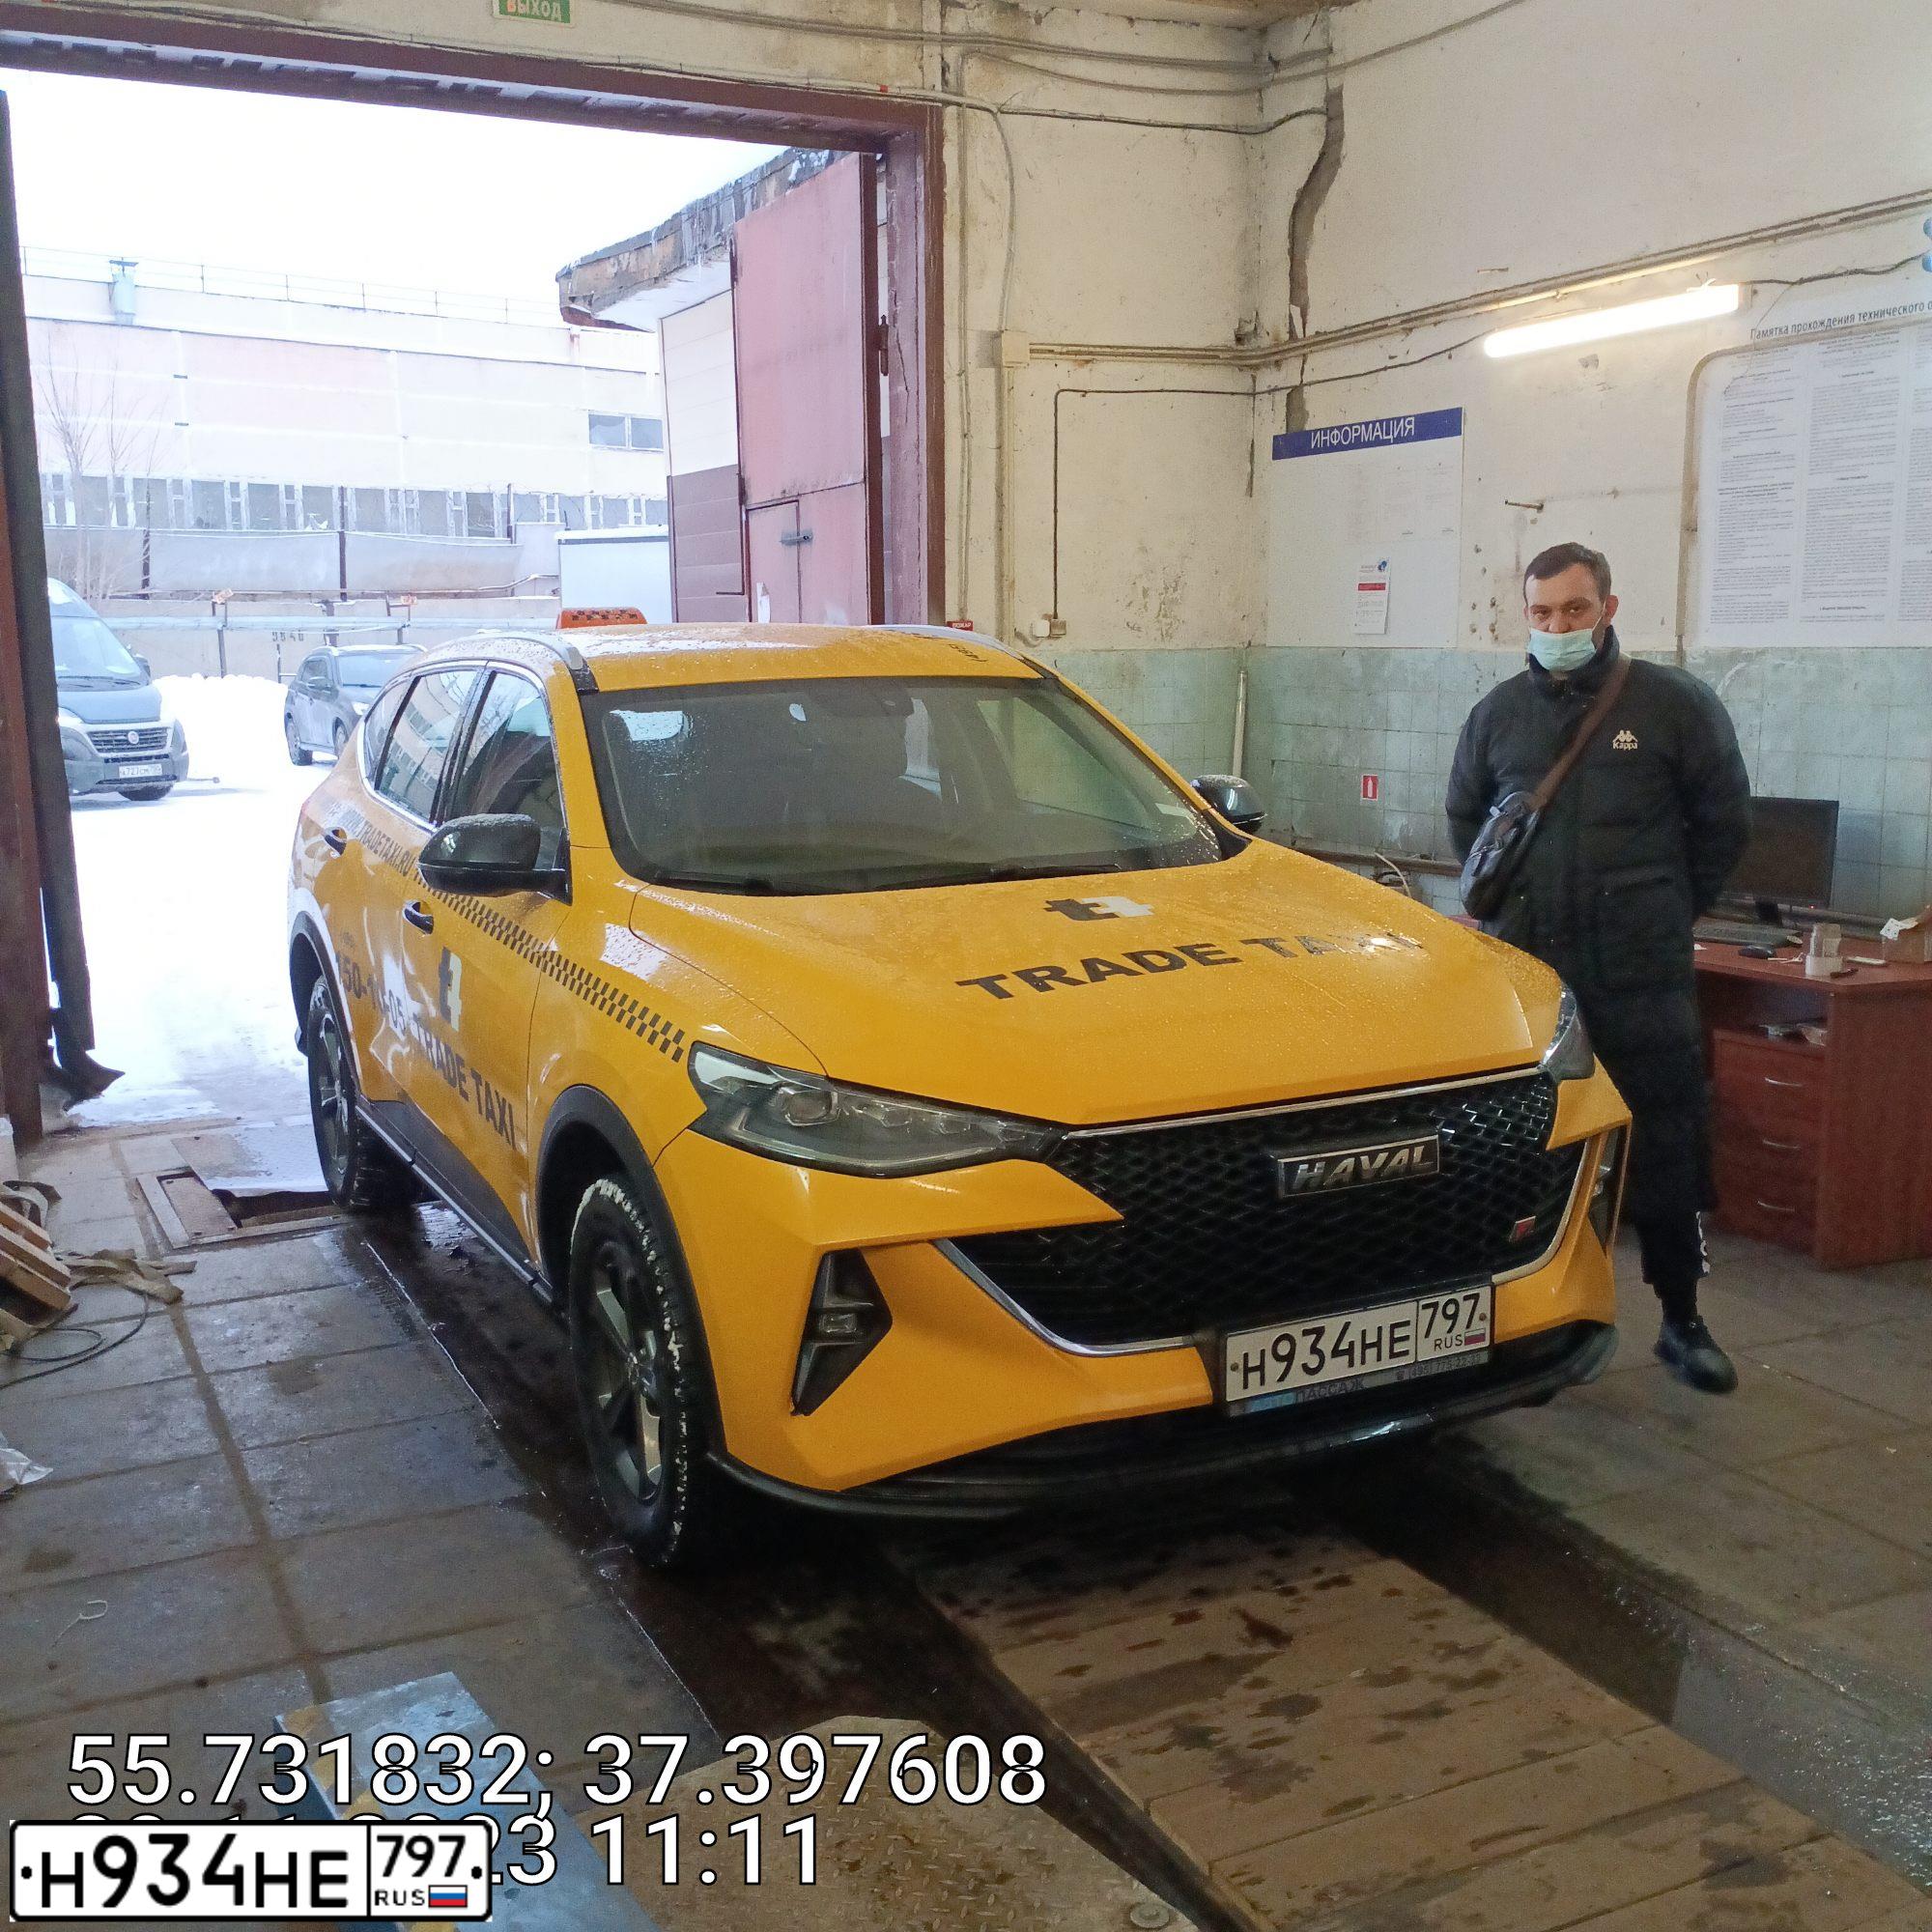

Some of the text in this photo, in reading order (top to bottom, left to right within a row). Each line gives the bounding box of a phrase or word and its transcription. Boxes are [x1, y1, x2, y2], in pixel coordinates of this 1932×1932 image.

[507, 0, 562, 21] ВЫХОД
[1790, 314, 1856, 334] прохождения
[1858, 301, 1925, 323] технического
[1310, 416, 1415, 449] ИНФОРМАЦИЯ
[1612, 741, 1638, 751] Kappa
[954, 941, 1243, 1000] TRADE
[412, 1012, 517, 1150] TRADE TAXI
[1291, 1145, 1434, 1191] HAVAL
[1241, 1293, 1481, 1390] Н934НЕ 797
[1434, 1333, 1463, 1351] RUS
